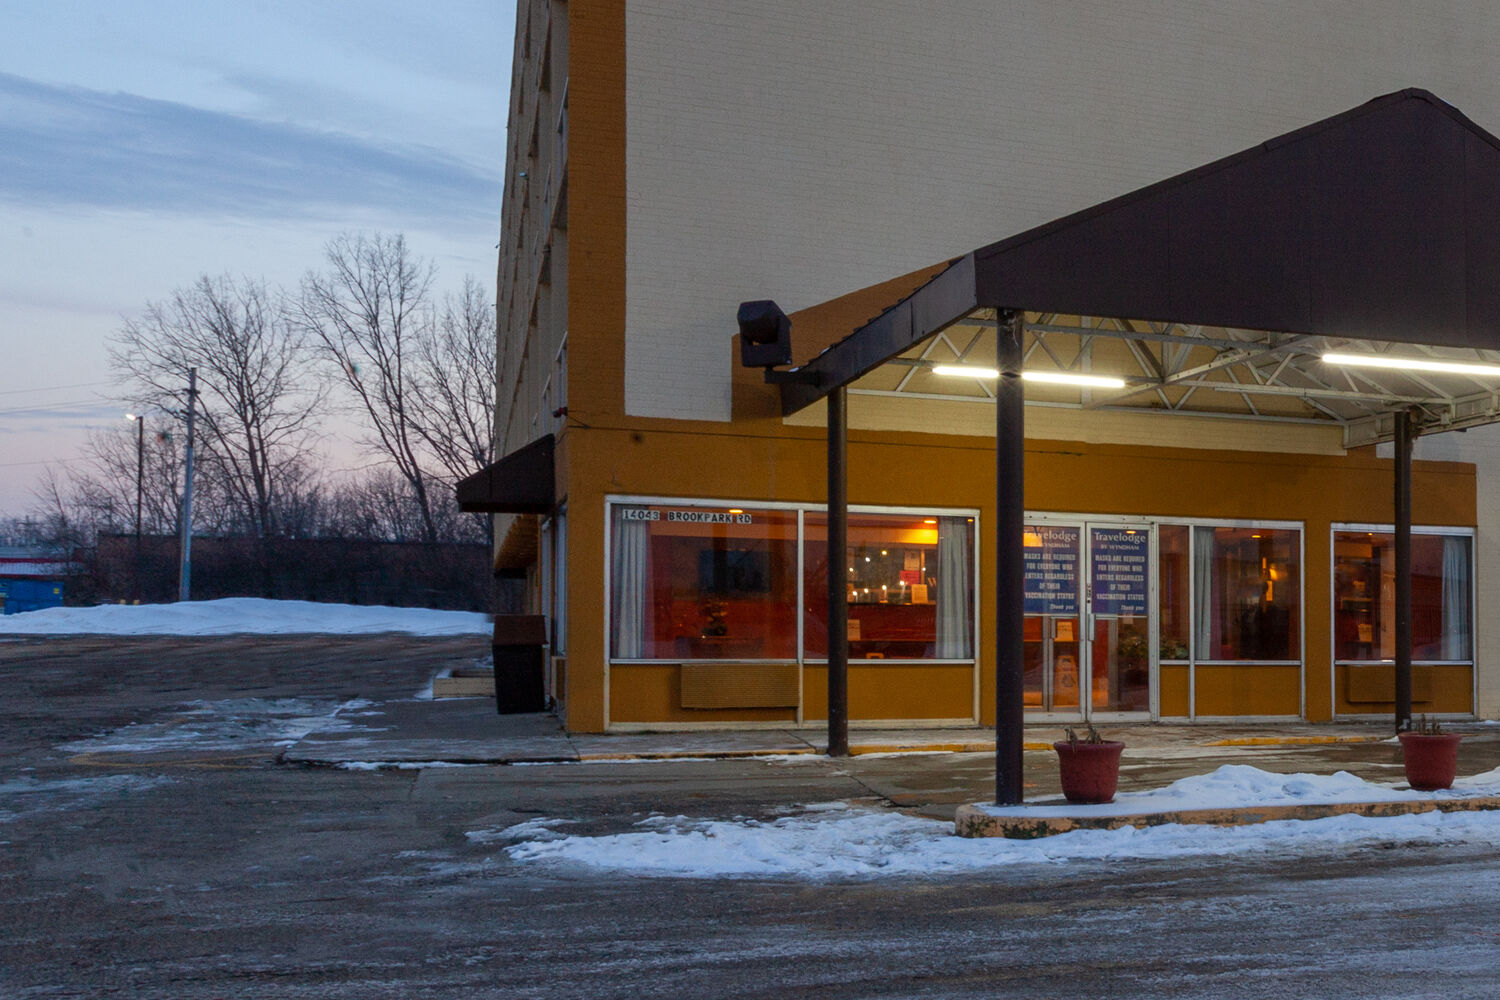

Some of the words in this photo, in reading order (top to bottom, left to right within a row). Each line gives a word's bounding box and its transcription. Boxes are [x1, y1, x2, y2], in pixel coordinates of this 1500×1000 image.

[624, 510, 659, 520] 14043
[669, 511, 732, 522] BROOKPARK
[737, 514, 751, 523] RD
[1094, 532, 1146, 544] Travelodge
